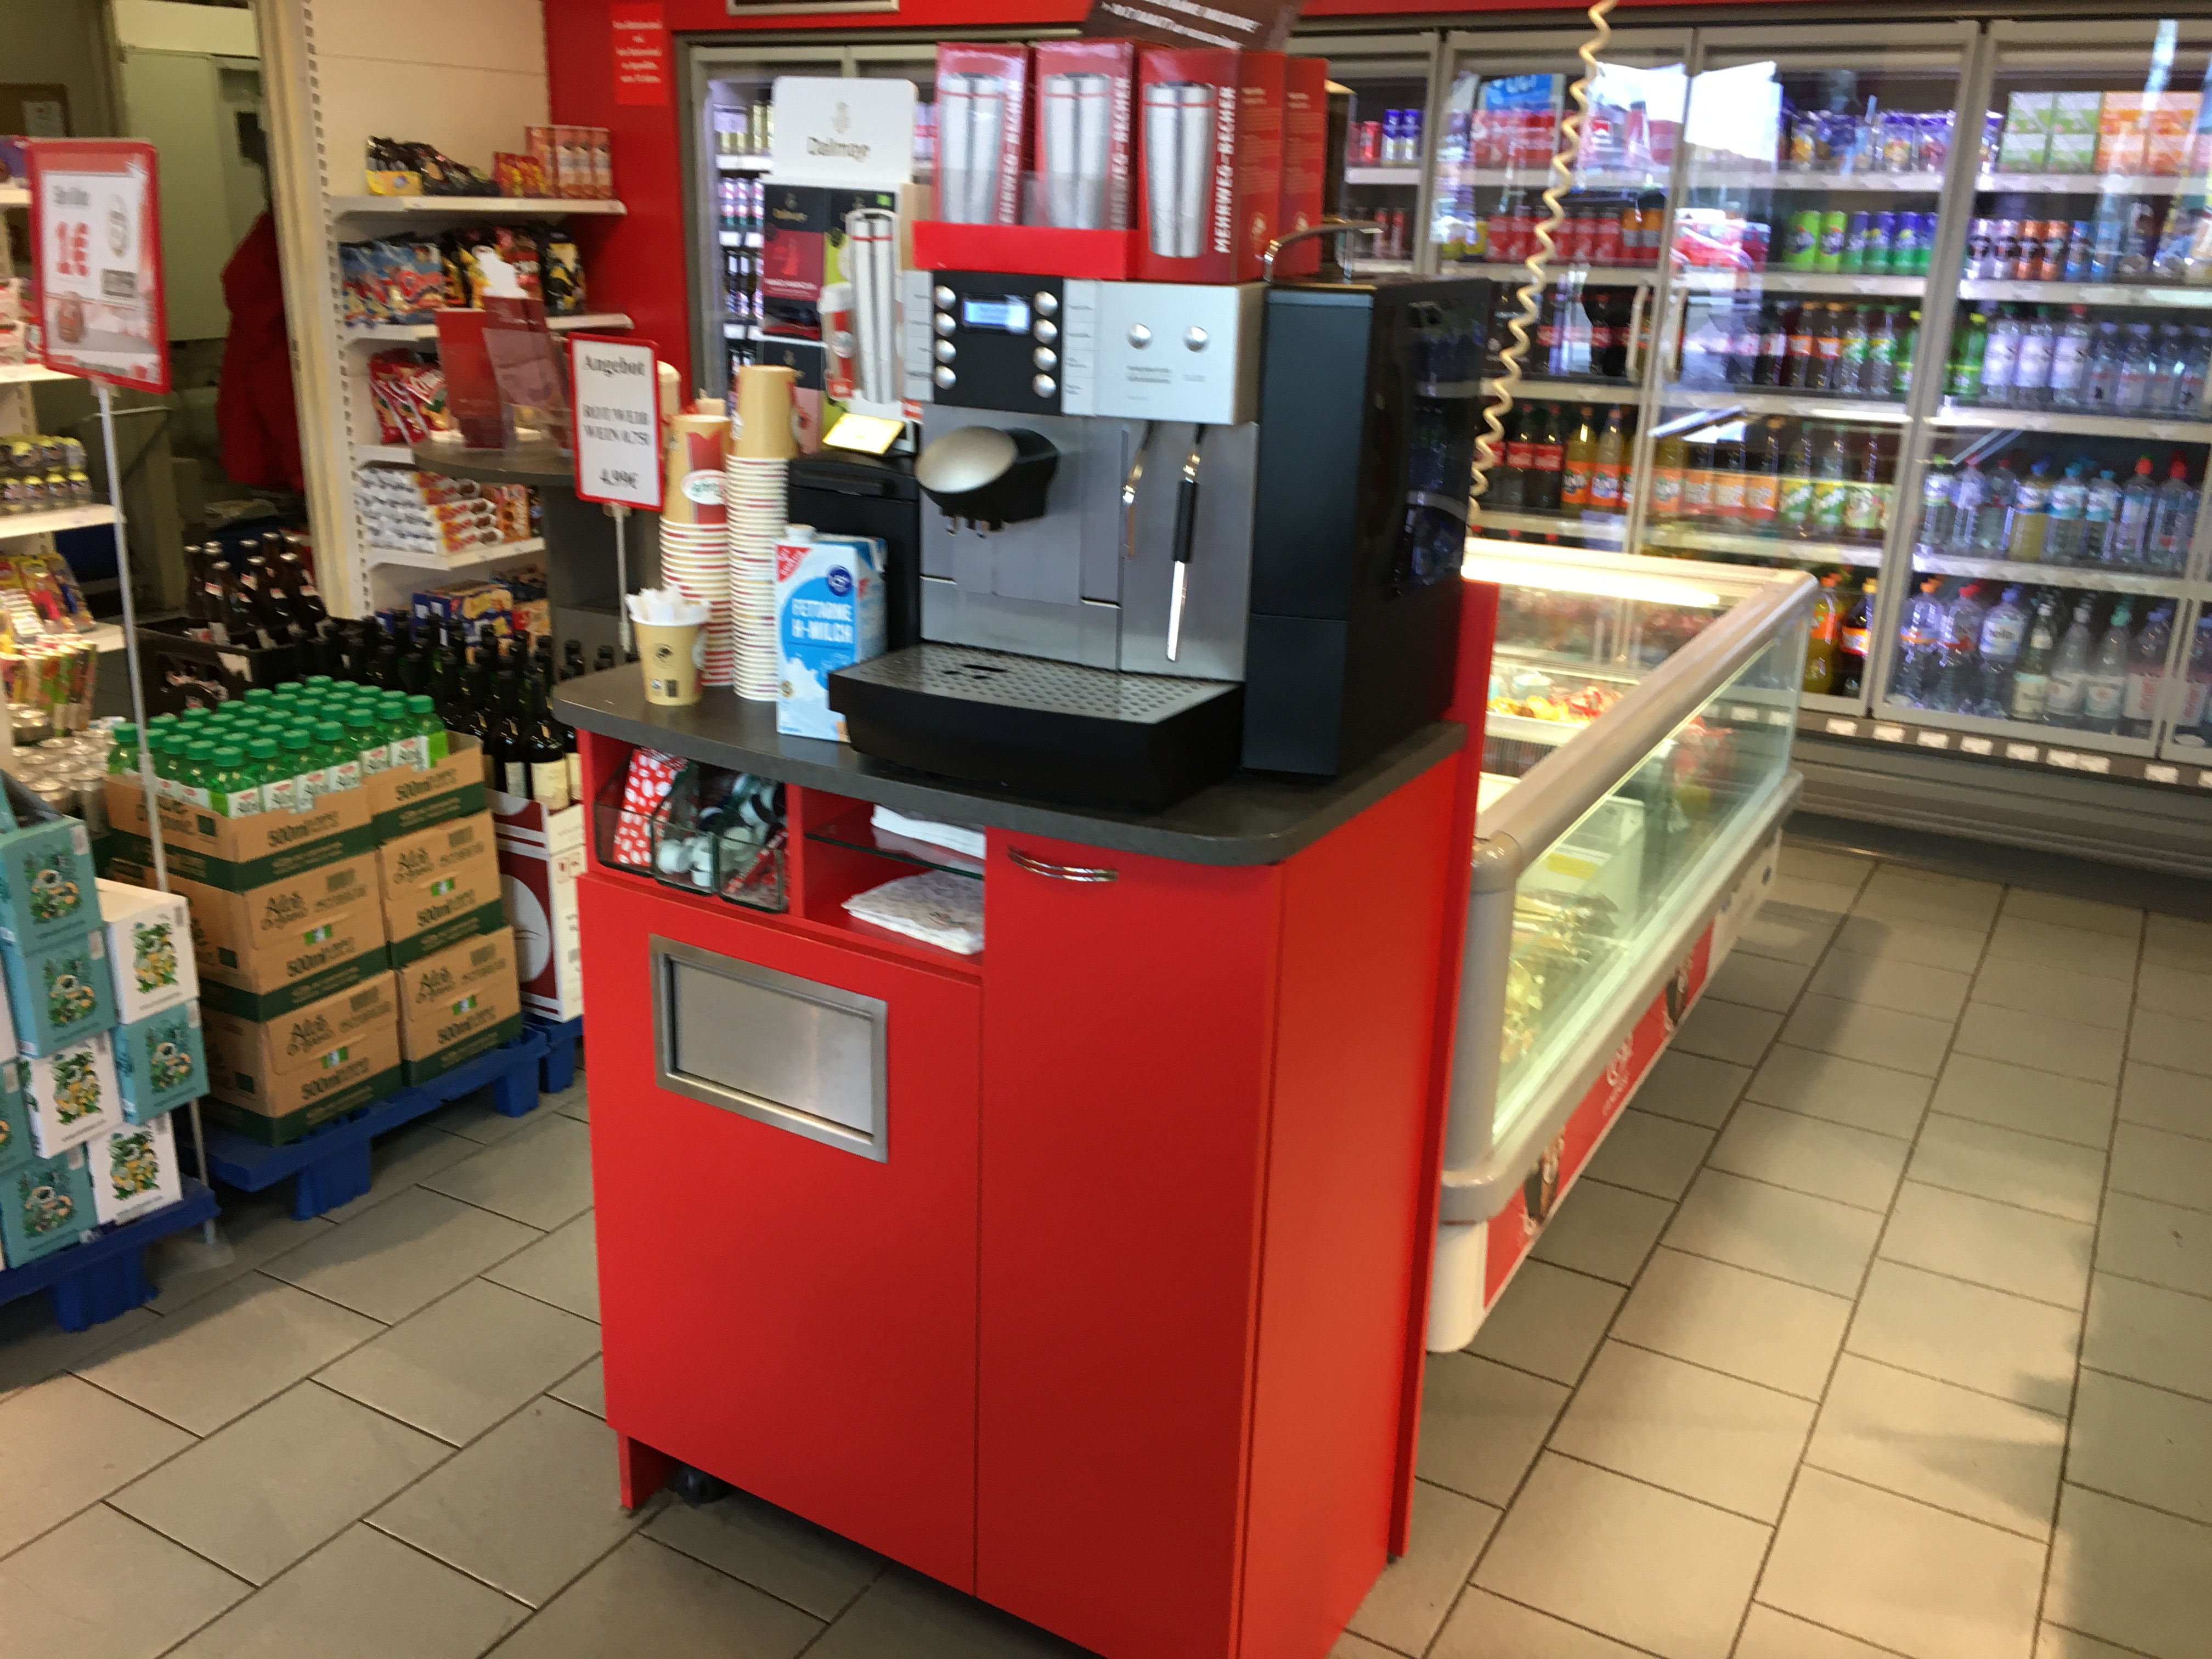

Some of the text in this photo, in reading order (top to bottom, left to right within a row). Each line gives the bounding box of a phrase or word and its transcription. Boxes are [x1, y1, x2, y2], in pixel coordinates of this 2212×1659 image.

[1214, 86, 1237, 253] MEHRWEG-BECHER
[584, 354, 646, 377] Angebot
[791, 618, 854, 644] H-MILCH
